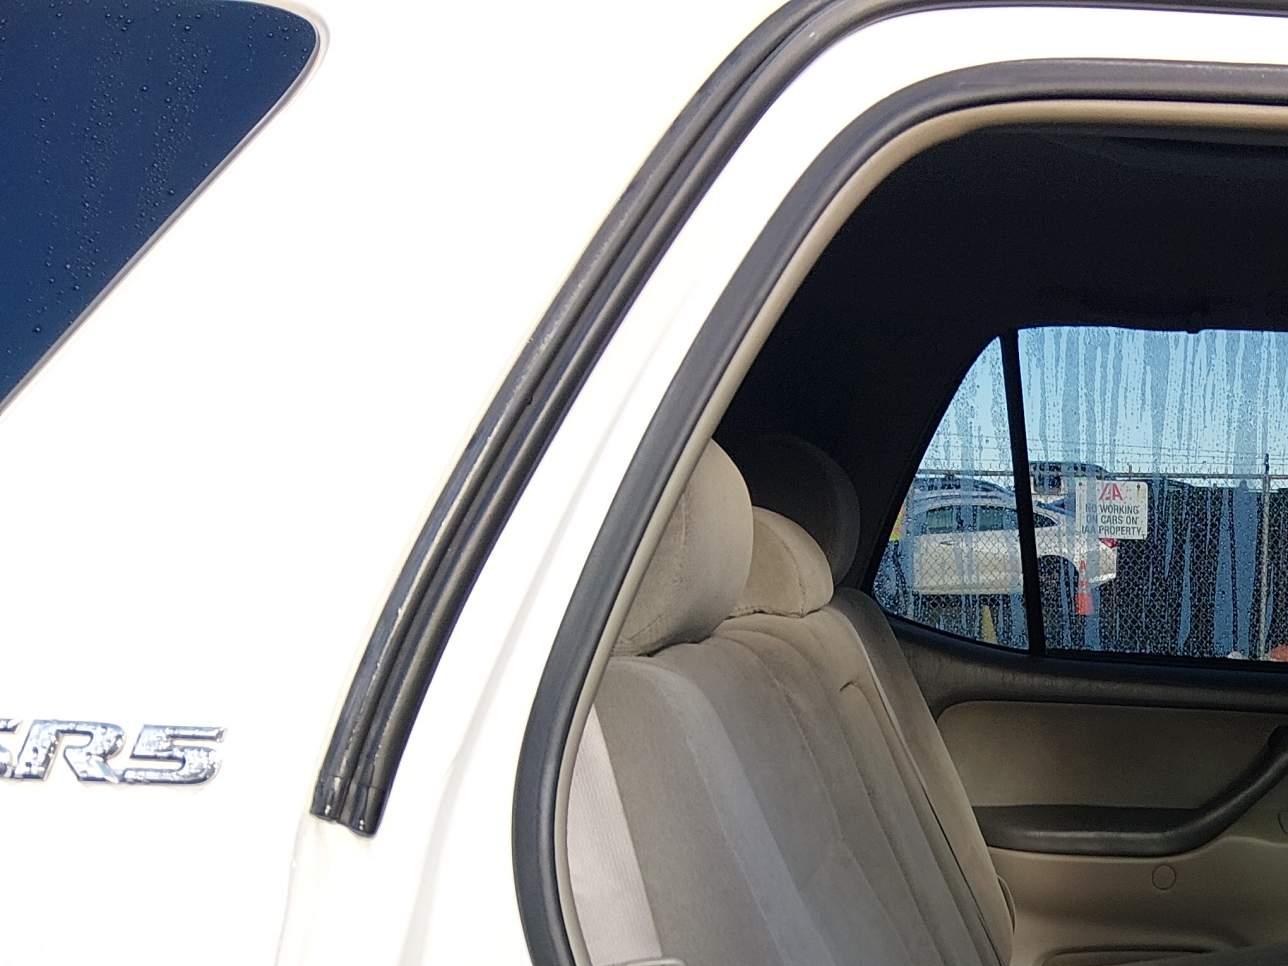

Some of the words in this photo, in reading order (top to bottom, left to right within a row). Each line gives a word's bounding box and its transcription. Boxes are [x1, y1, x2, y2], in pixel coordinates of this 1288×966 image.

[1085, 503, 1097, 513] NO
[1099, 503, 1139, 515] WORKING
[1086, 514, 1098, 524] ON
[1100, 514, 1123, 525] CARS
[1125, 515, 1138, 525] ON
